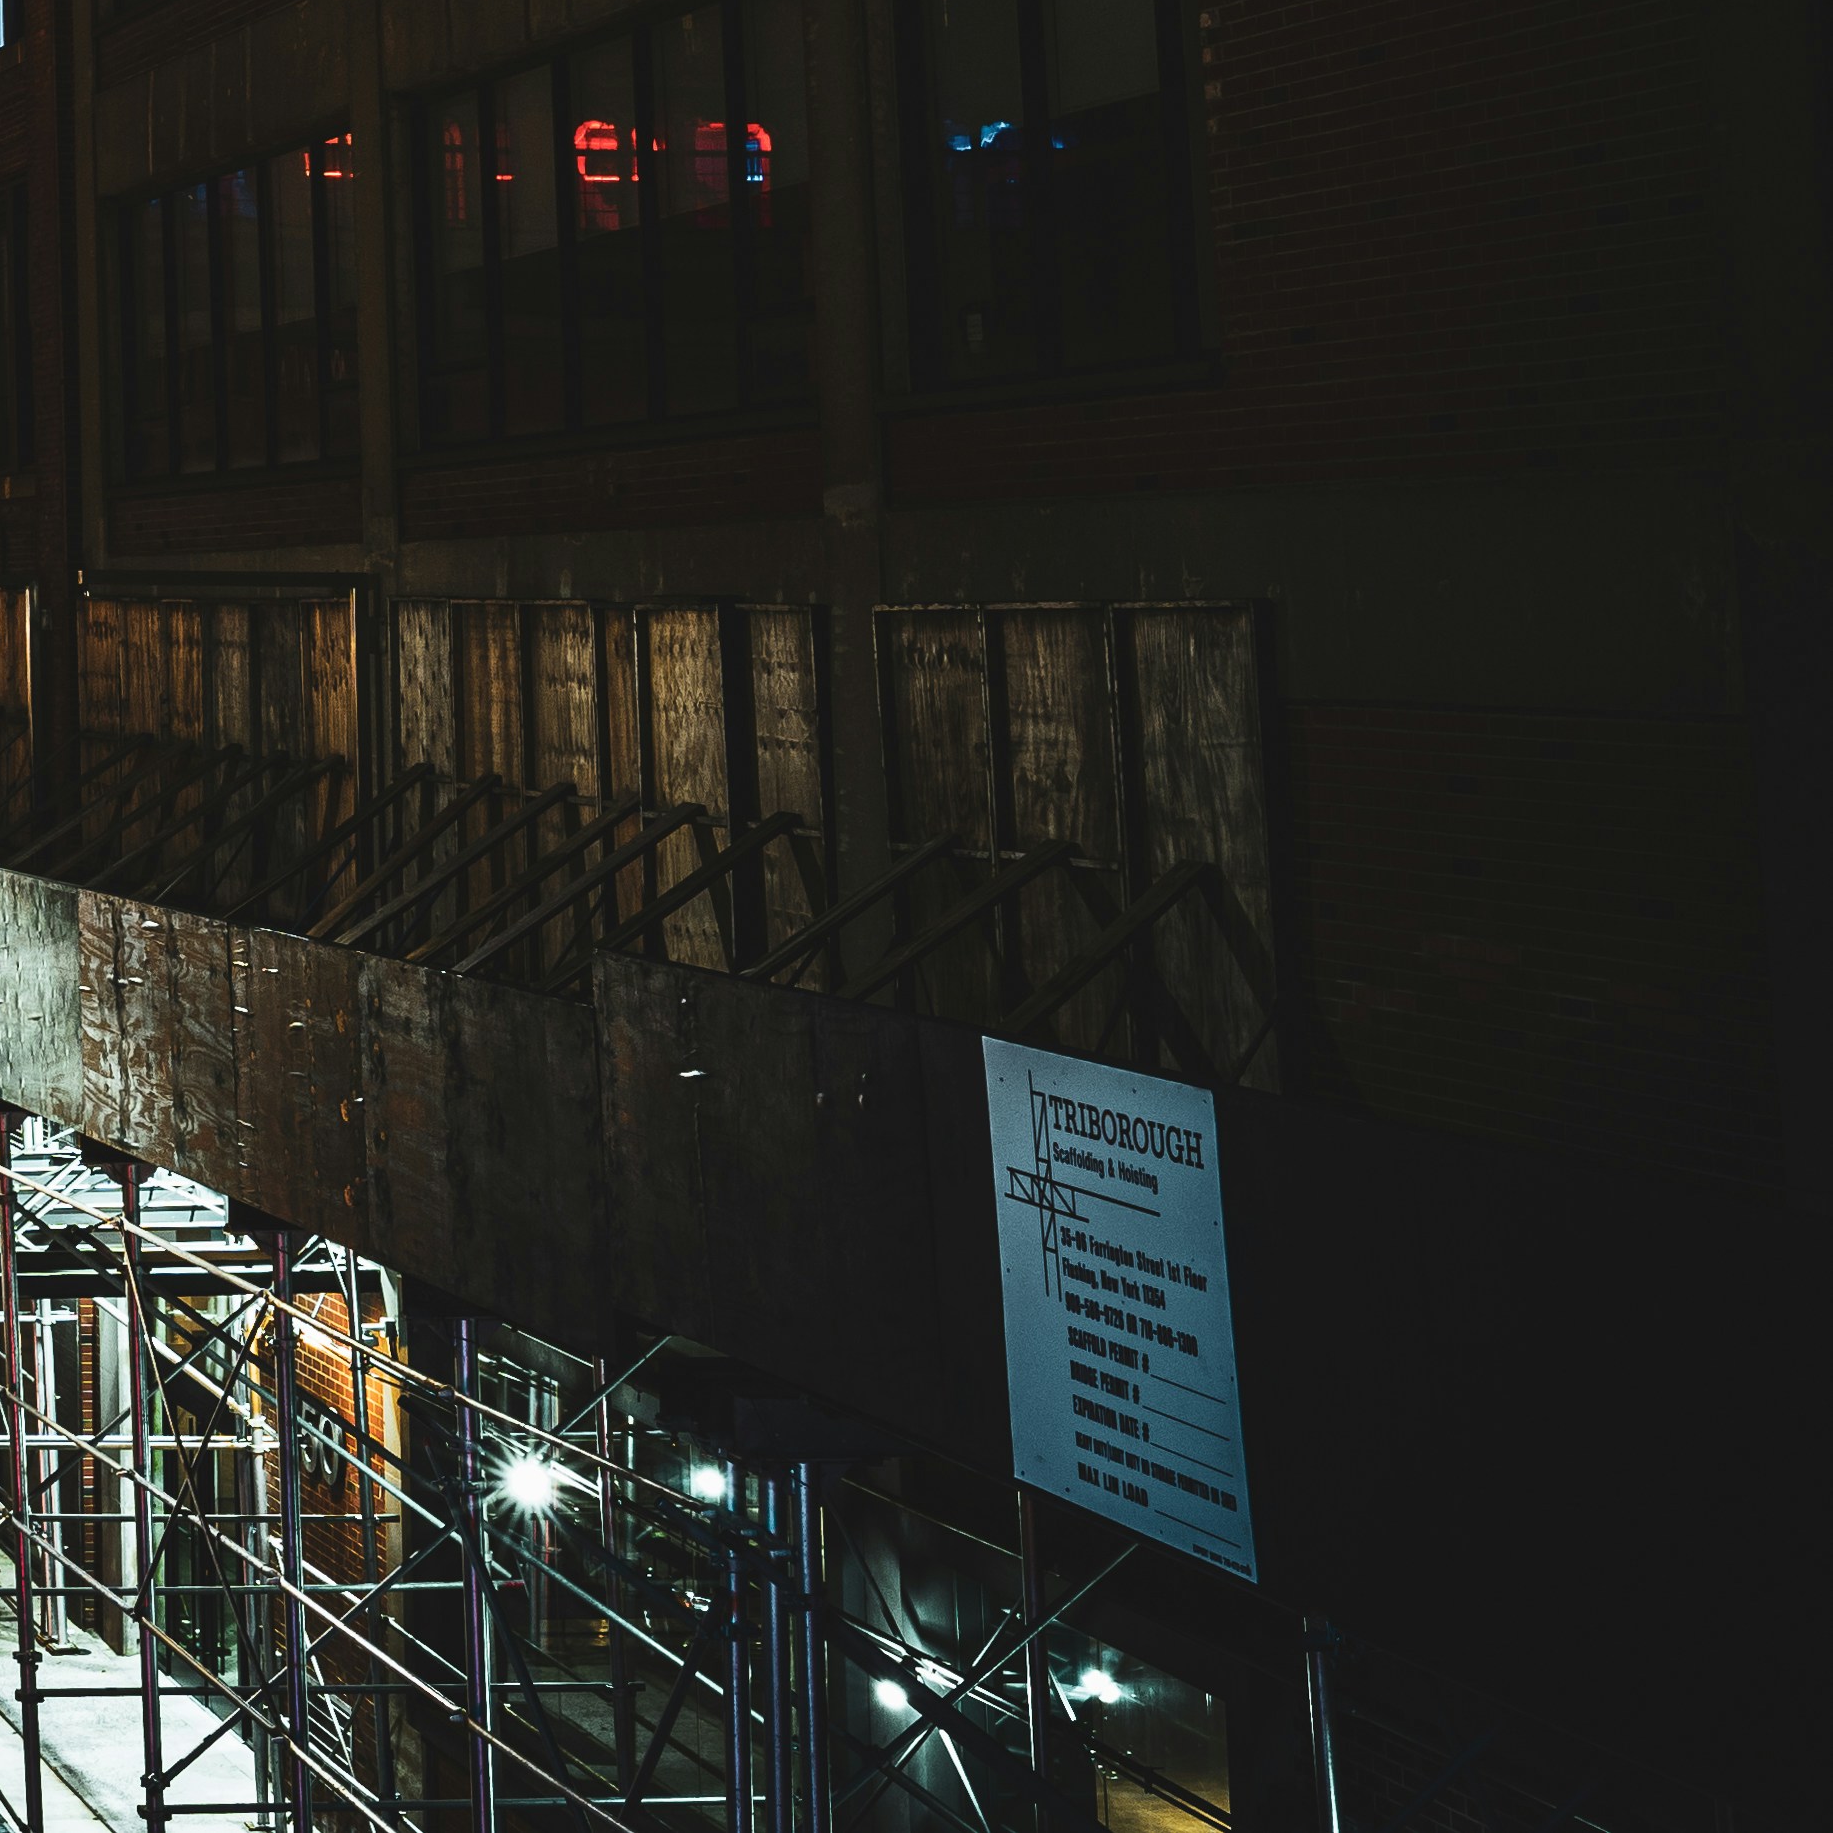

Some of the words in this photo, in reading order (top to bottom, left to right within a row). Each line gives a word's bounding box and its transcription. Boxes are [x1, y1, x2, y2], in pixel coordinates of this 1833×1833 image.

[1049, 1095, 1204, 1169] TRIBOROUGH
[1053, 1142, 1104, 1179] Scaffolding
[1108, 1158, 1115, 1178] &
[1118, 1161, 1158, 1195] Hoisting
[1089, 1235, 1134, 1267] Farrington
[1136, 1251, 1165, 1278] Street
[1167, 1260, 1181, 1284] 1st
[1184, 1266, 1207, 1292] Floor
[1121, 1276, 1140, 1302] York
[1068, 1326, 1106, 1358] SCAFFOLD
[1109, 1340, 1138, 1369] PERMIT
[1100, 1371, 1129, 1400] PERMIT
[1073, 1394, 1117, 1430] EXPIRATION
[1119, 1413, 1140, 1439] DATE
[1078, 1462, 1100, 1487] MAX
[1123, 1481, 1148, 1507] LOAD
